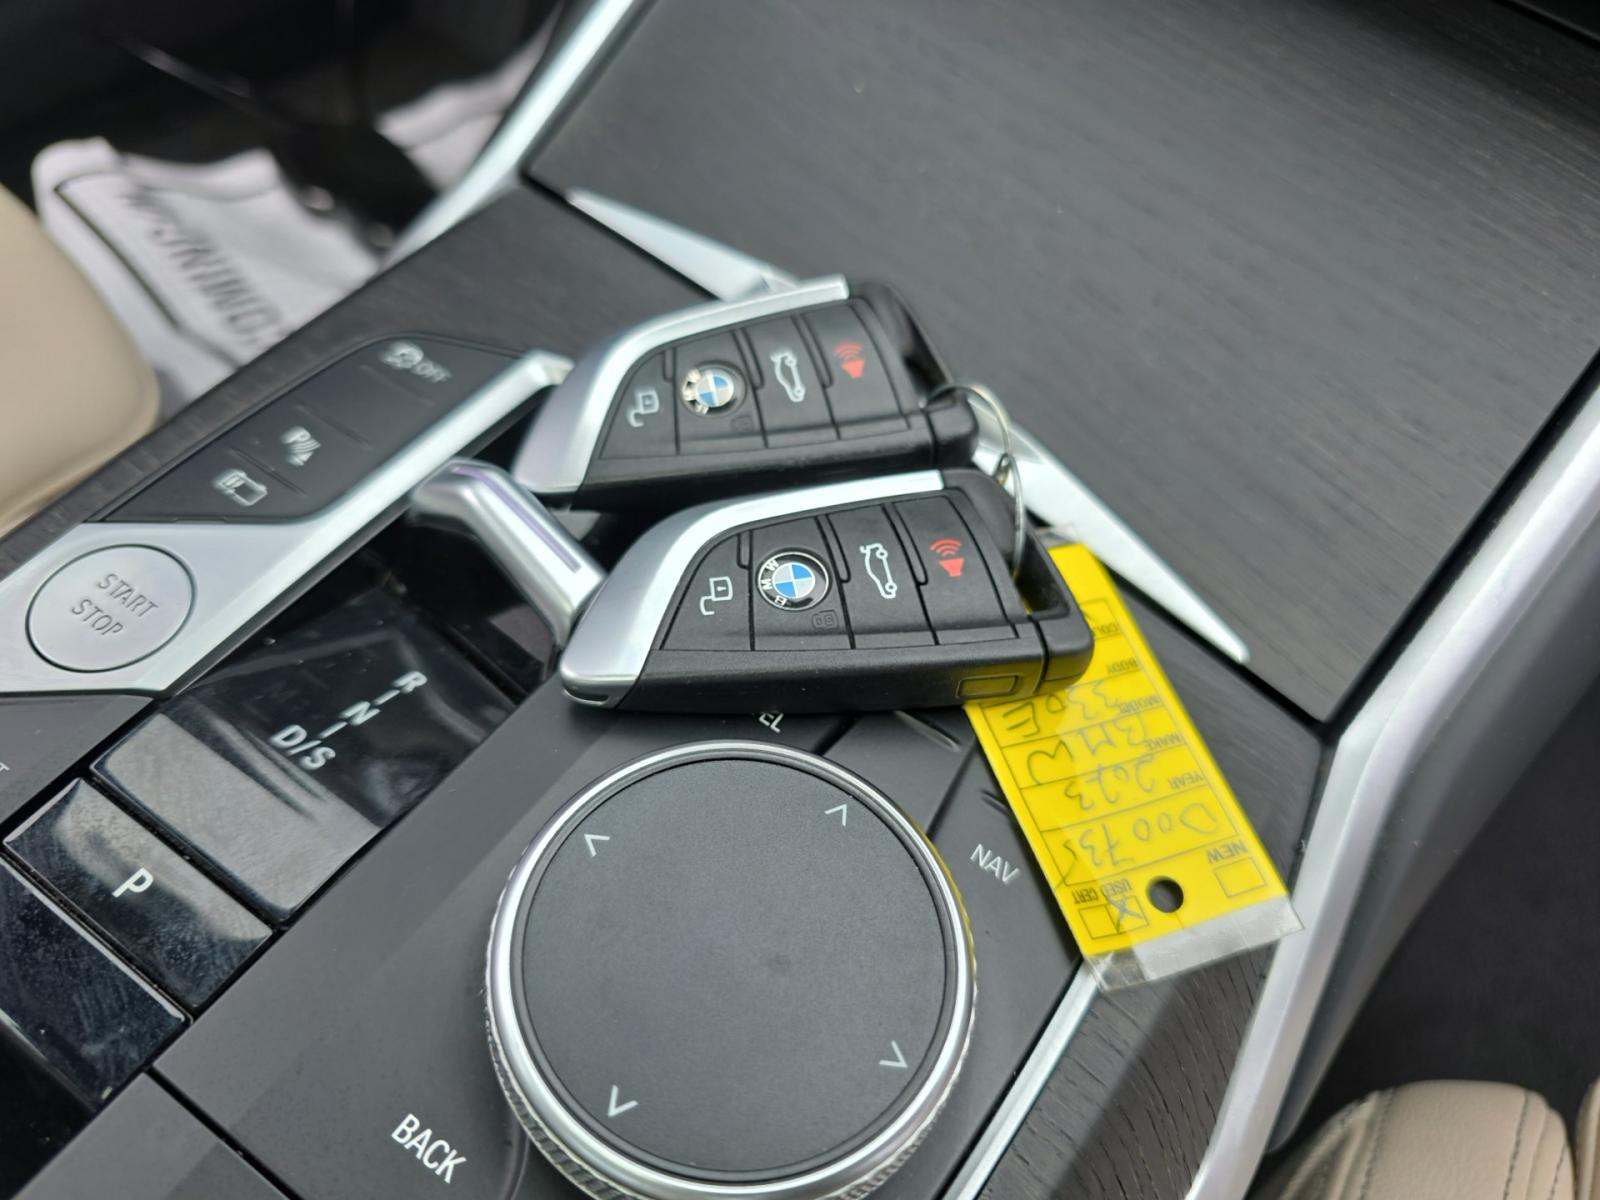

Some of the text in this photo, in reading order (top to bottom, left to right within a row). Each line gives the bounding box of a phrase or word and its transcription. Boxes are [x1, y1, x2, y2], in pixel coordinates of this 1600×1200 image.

[94, 572, 159, 619] START
[70, 599, 127, 637] STOP
[1107, 658, 1140, 675] BODY
[396, 671, 428, 694] R
[343, 699, 382, 725] N
[755, 711, 784, 733] EL
[1003, 680, 1119, 738] 330E
[270, 723, 336, 770] D/S
[1027, 715, 1148, 785] BMW
[1144, 733, 1183, 750] MAKE
[1064, 755, 1155, 810] 2023
[1168, 771, 1206, 790] YEAR
[969, 843, 1020, 885] NAV
[1207, 839, 1248, 864] NEW
[112, 867, 154, 898] P
[1071, 878, 1133, 905] USED CERT
[390, 1113, 467, 1186] BACK
